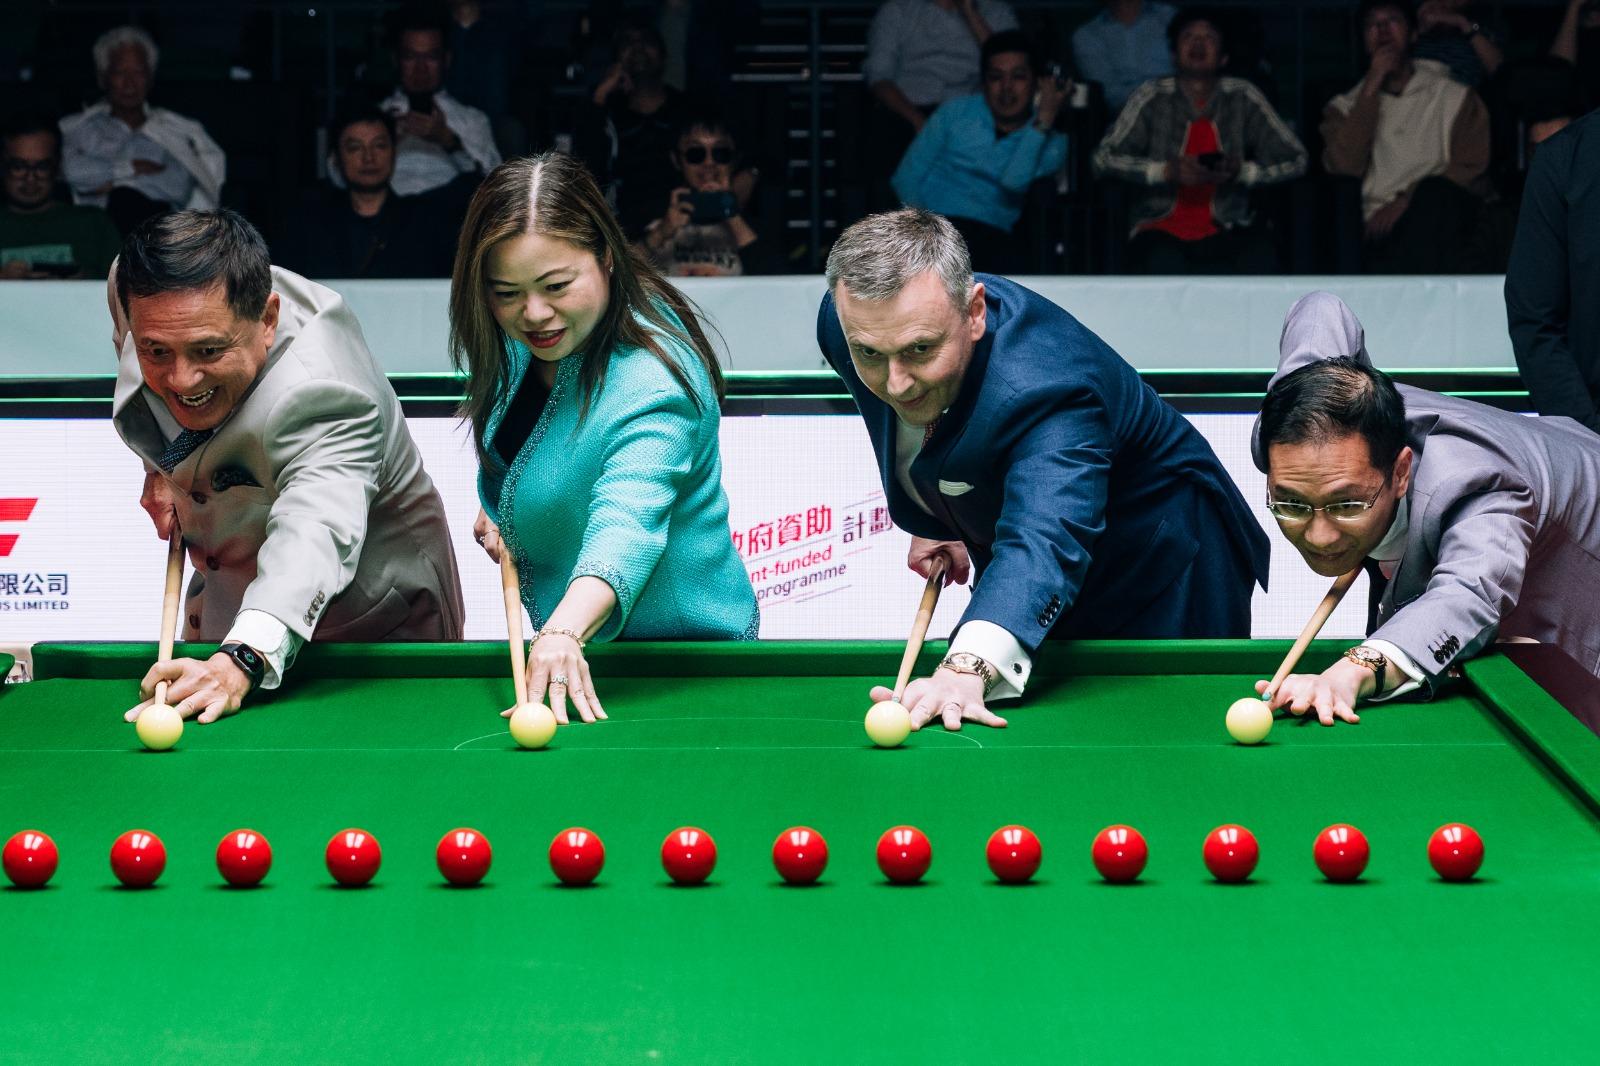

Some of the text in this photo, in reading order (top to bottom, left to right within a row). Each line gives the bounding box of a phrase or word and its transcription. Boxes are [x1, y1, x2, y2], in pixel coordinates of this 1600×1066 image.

[751, 545, 832, 583] nt-funded
[757, 564, 846, 601] programme
[15, 601, 69, 610] LIMITED
